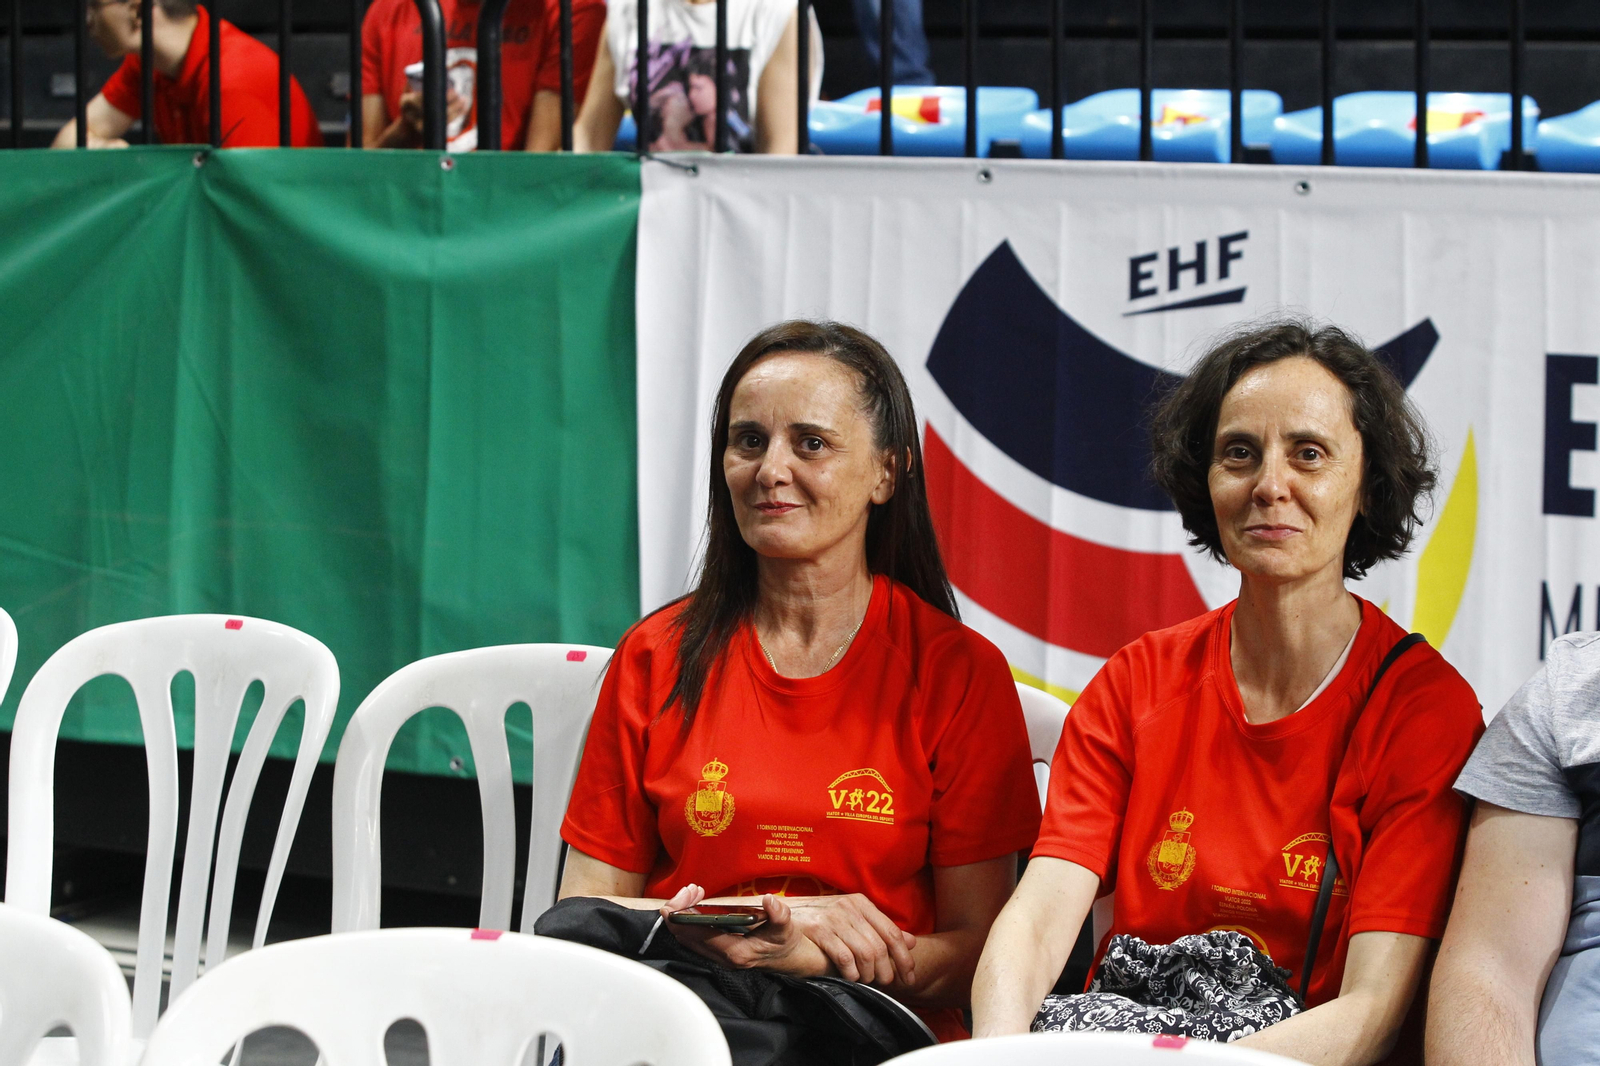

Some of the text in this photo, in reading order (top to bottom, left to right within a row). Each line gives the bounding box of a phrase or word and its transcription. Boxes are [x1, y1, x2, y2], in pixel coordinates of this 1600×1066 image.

[1129, 230, 1249, 301] EHF
[866, 790, 894, 815] 22
[1213, 884, 1231, 894] TORNEO
[1231, 888, 1266, 900] INTERNACIONAL
[1224, 895, 1240, 903] VIATOR
